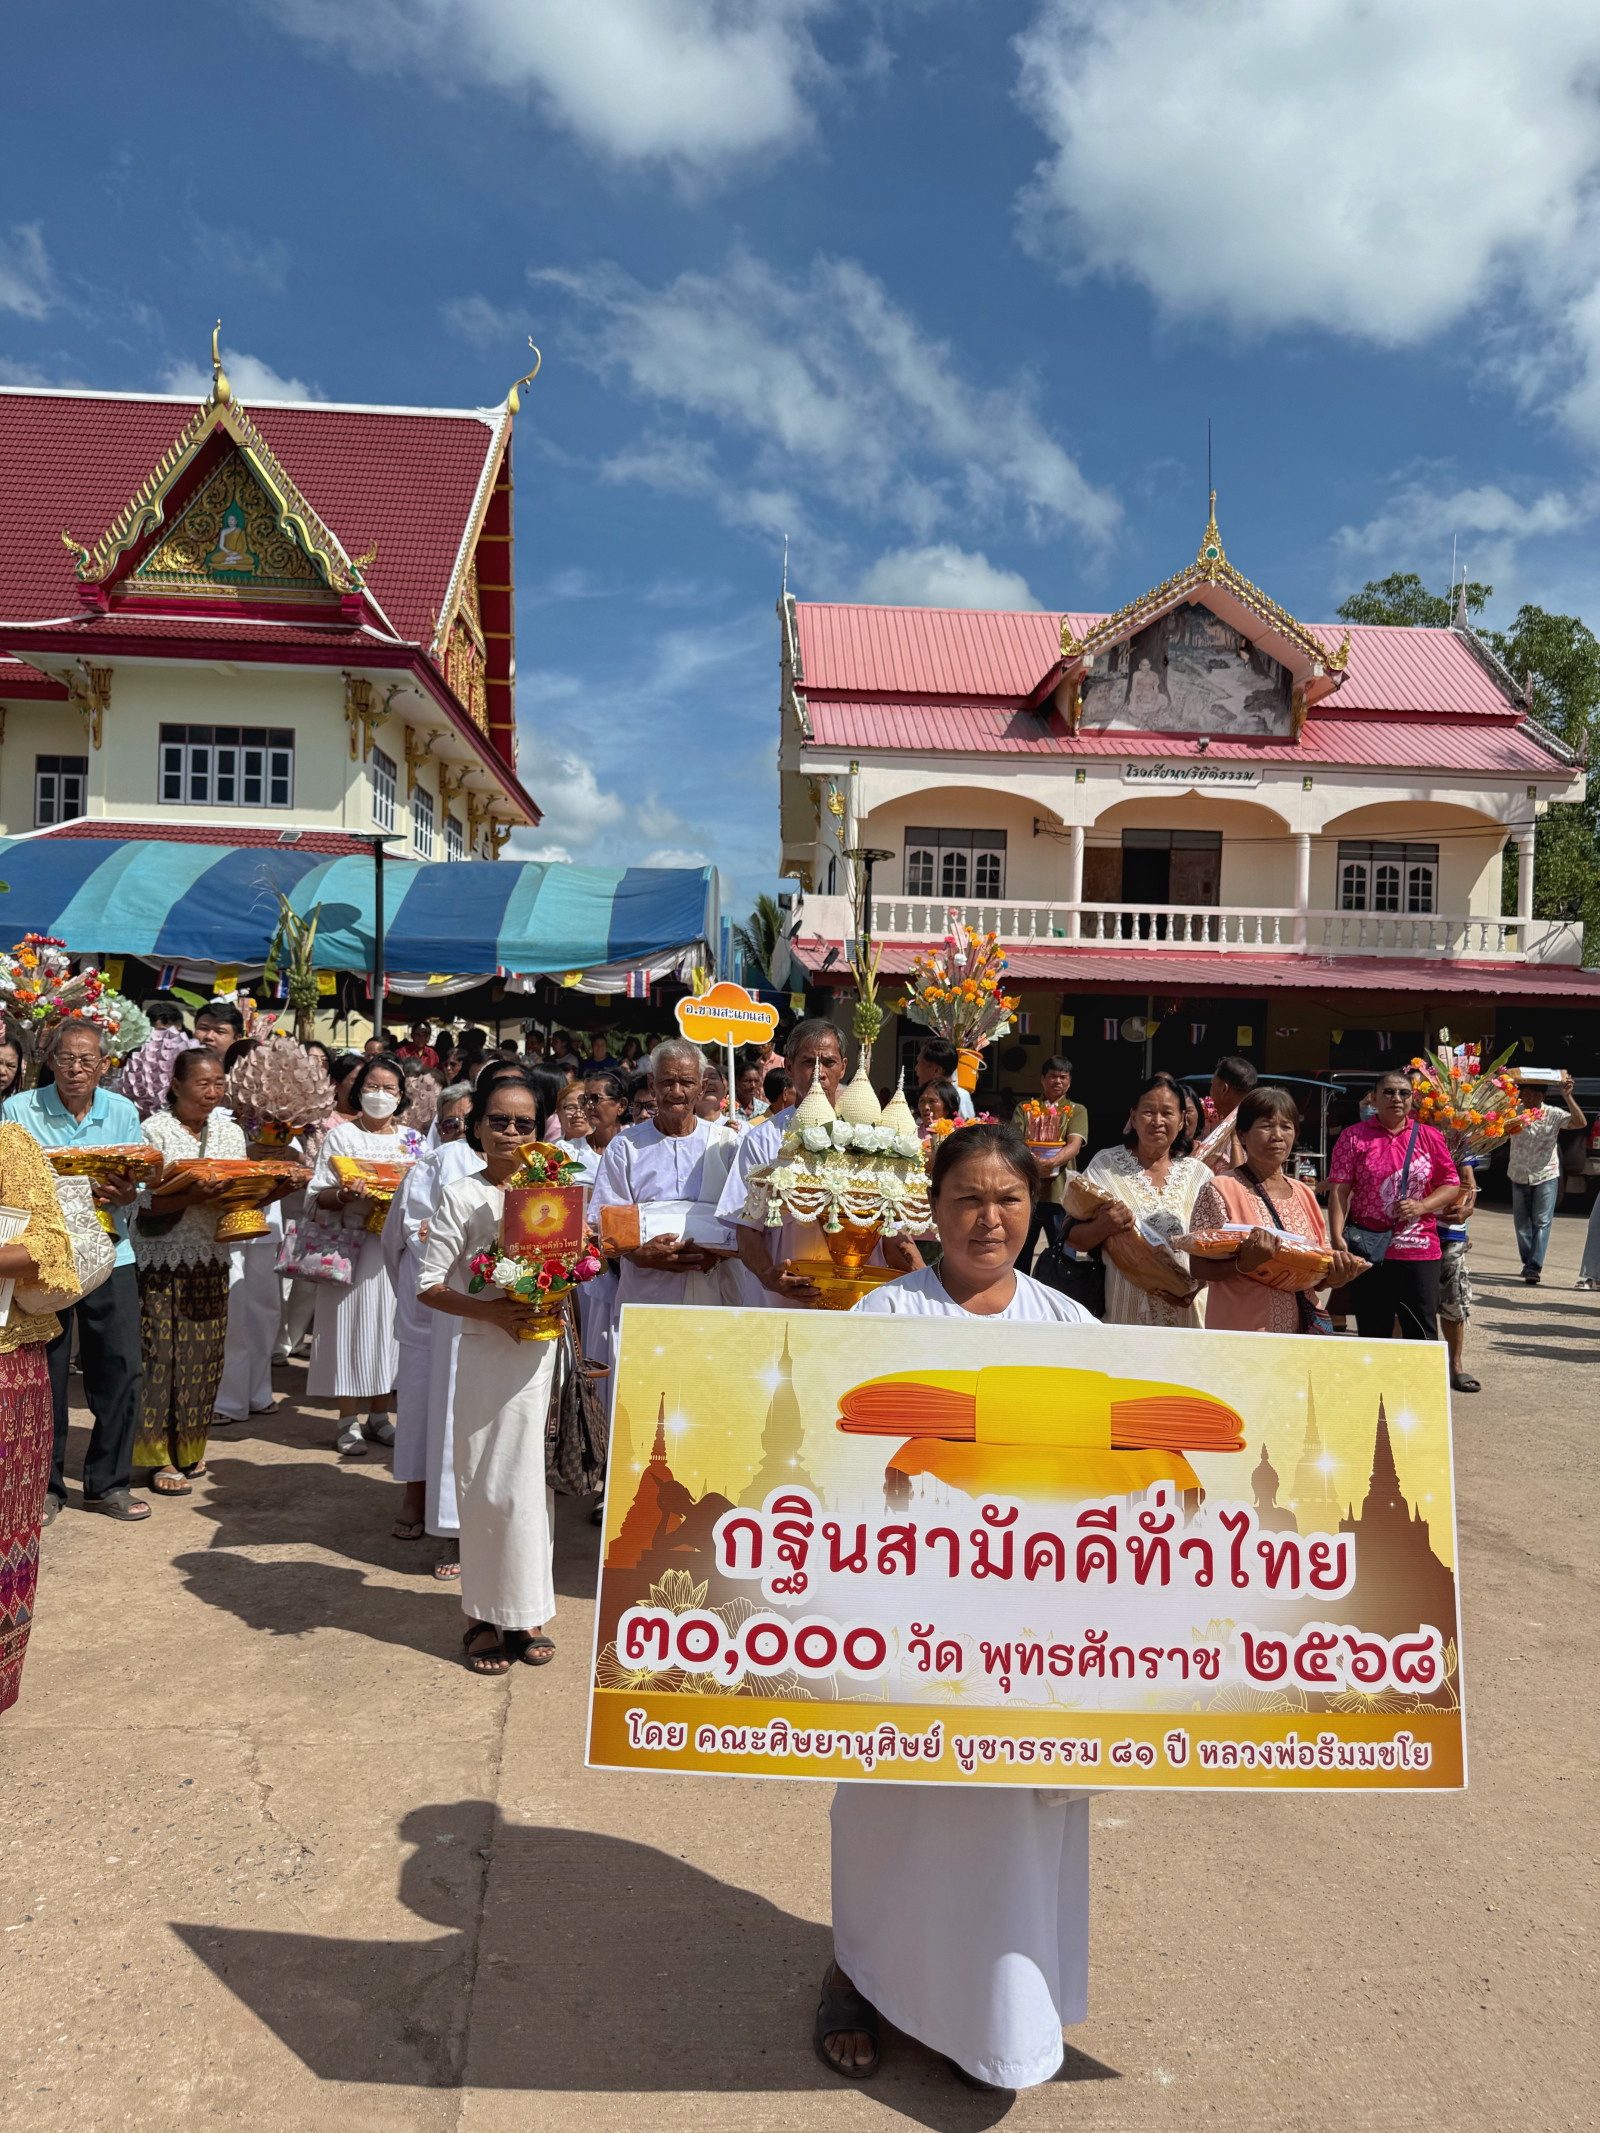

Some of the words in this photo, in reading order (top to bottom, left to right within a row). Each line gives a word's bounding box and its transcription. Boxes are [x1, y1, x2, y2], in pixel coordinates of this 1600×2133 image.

[685, 1004, 771, 1024] อ.ขามสะแกแสง
[722, 1489, 1347, 1595] กฐินสามัคคีทั่วไทย
[625, 1616, 887, 1675] ๓๐,๐๐๐
[907, 1622, 963, 1673] วัด
[979, 1628, 1221, 1694] พุทธศักราช
[1240, 1631, 1436, 1684] ๒๕๖๘
[629, 1713, 684, 1747] โดย
[698, 1722, 942, 1767] คณะศิษยานุศิษย์
[954, 1739, 1099, 1771] บูชาธรรม
[1112, 1743, 1154, 1765] ๘๑
[1166, 1732, 1187, 1764] ปี
[1200, 1734, 1430, 1767] หลวงพ่อธัมมชโย
